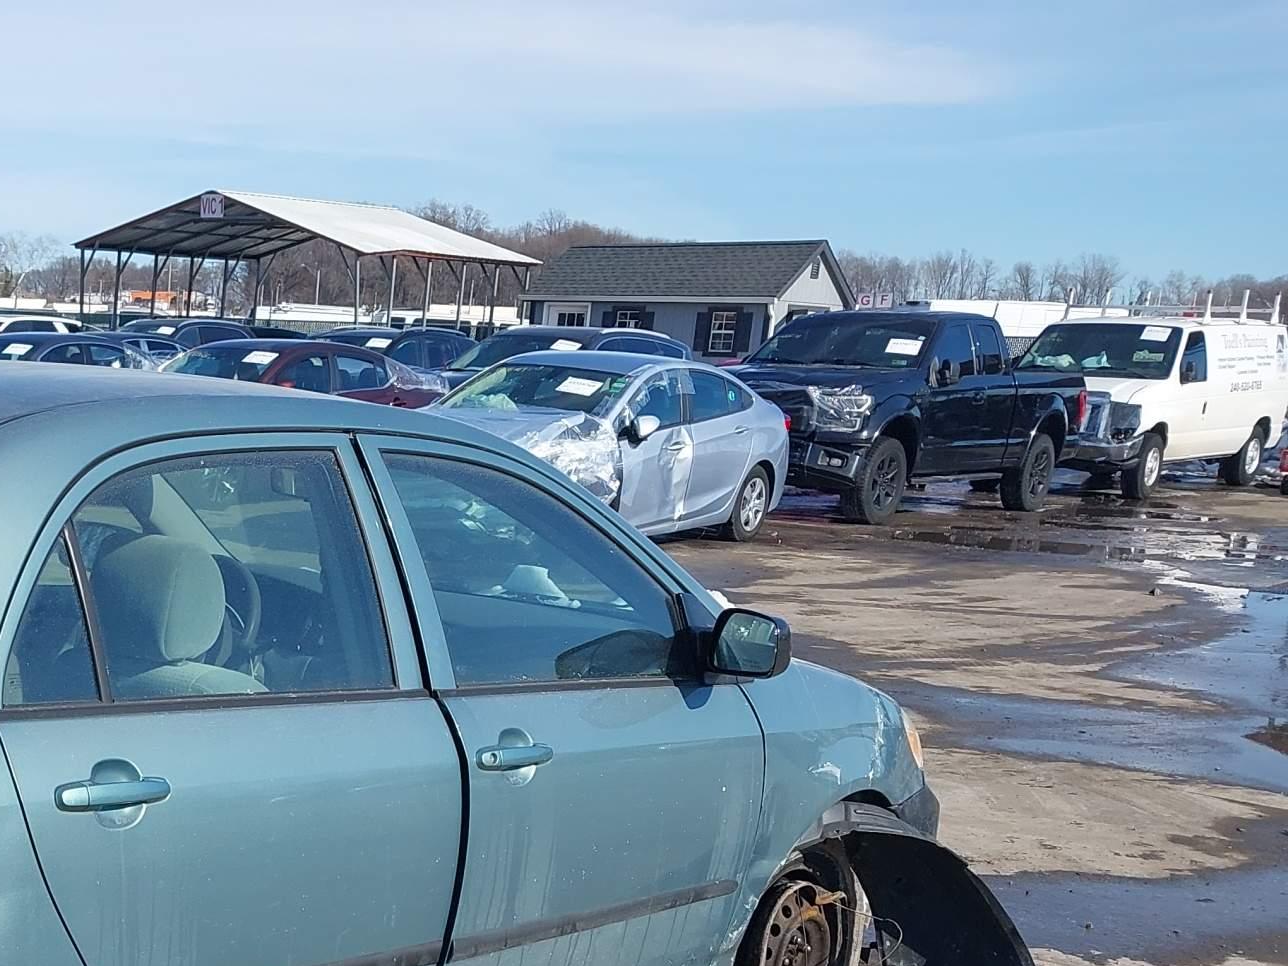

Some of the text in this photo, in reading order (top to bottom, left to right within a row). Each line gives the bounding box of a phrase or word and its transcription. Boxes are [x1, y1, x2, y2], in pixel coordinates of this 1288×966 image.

[202, 197, 217, 215] VIC
[860, 295, 871, 306] G
[880, 294, 889, 306] F
